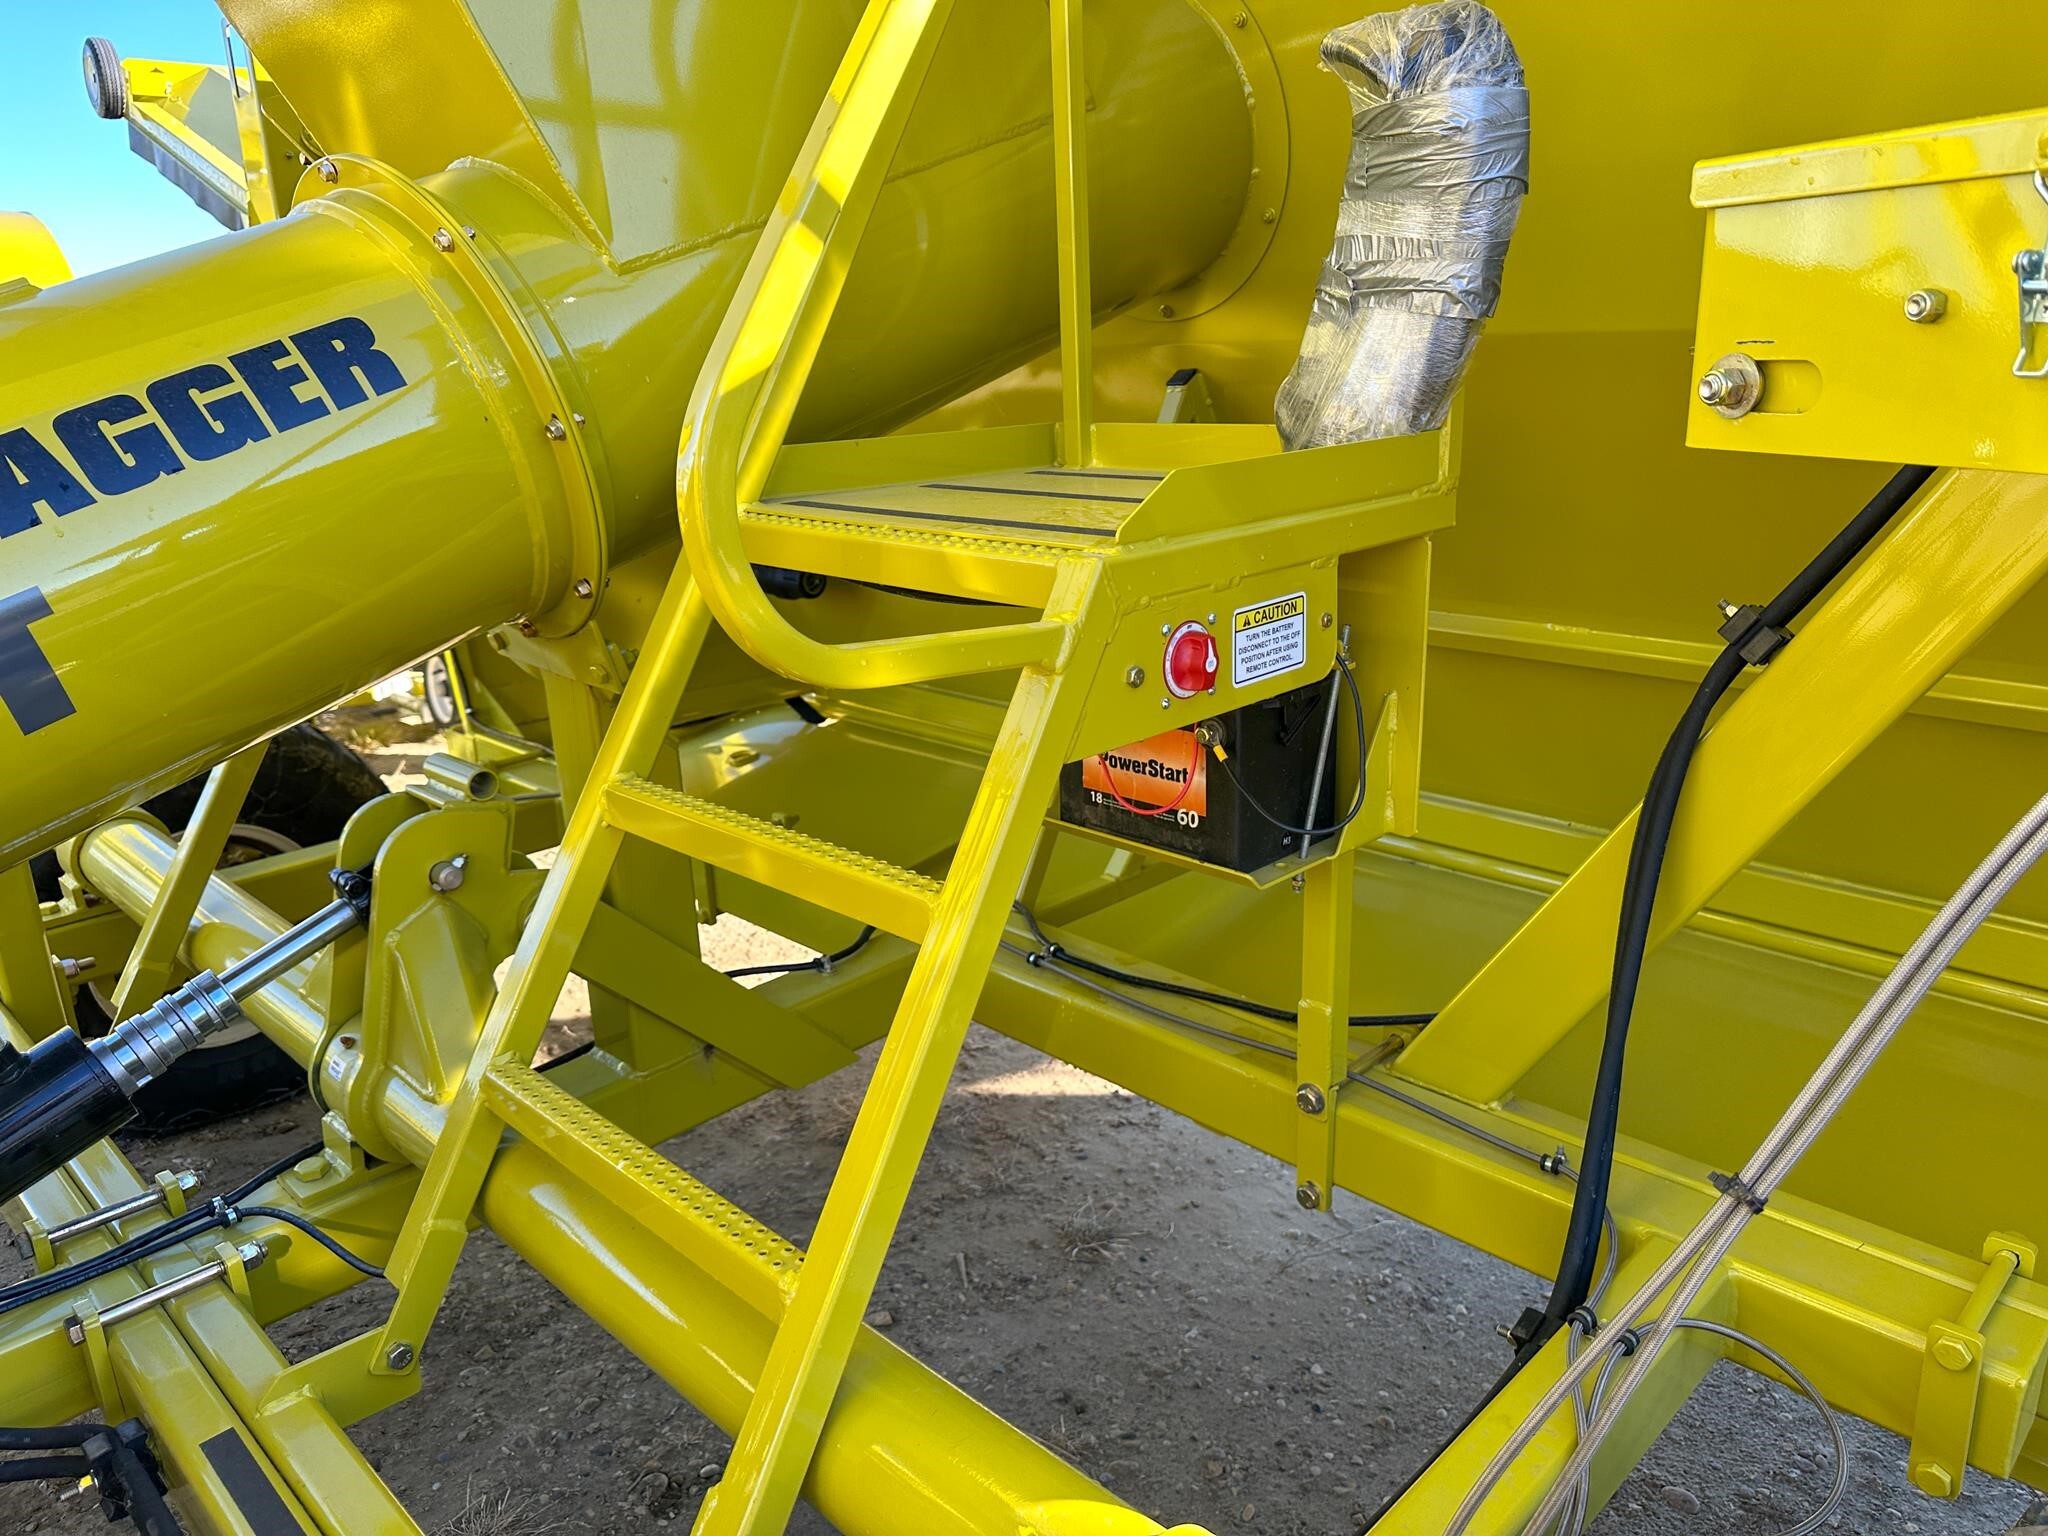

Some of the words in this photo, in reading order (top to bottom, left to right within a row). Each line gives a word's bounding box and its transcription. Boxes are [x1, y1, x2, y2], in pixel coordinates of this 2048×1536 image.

[1254, 600, 1297, 624] CAUTION
[1239, 640, 1271, 655] DISCONNECT
[1272, 636, 1280, 645] TO
[1281, 633, 1290, 642] THE
[1291, 630, 1301, 639] OFF
[1246, 632, 1260, 642] TURN
[1261, 628, 1271, 638] THE
[1272, 623, 1294, 635] BATTERY
[1241, 651, 1265, 664] POSITION
[1266, 646, 1283, 657] AFTER
[1283, 641, 1299, 652] USING
[1246, 661, 1267, 673] REMOTE
[1090, 791, 1103, 804] 18
[1176, 808, 1199, 828] 60
